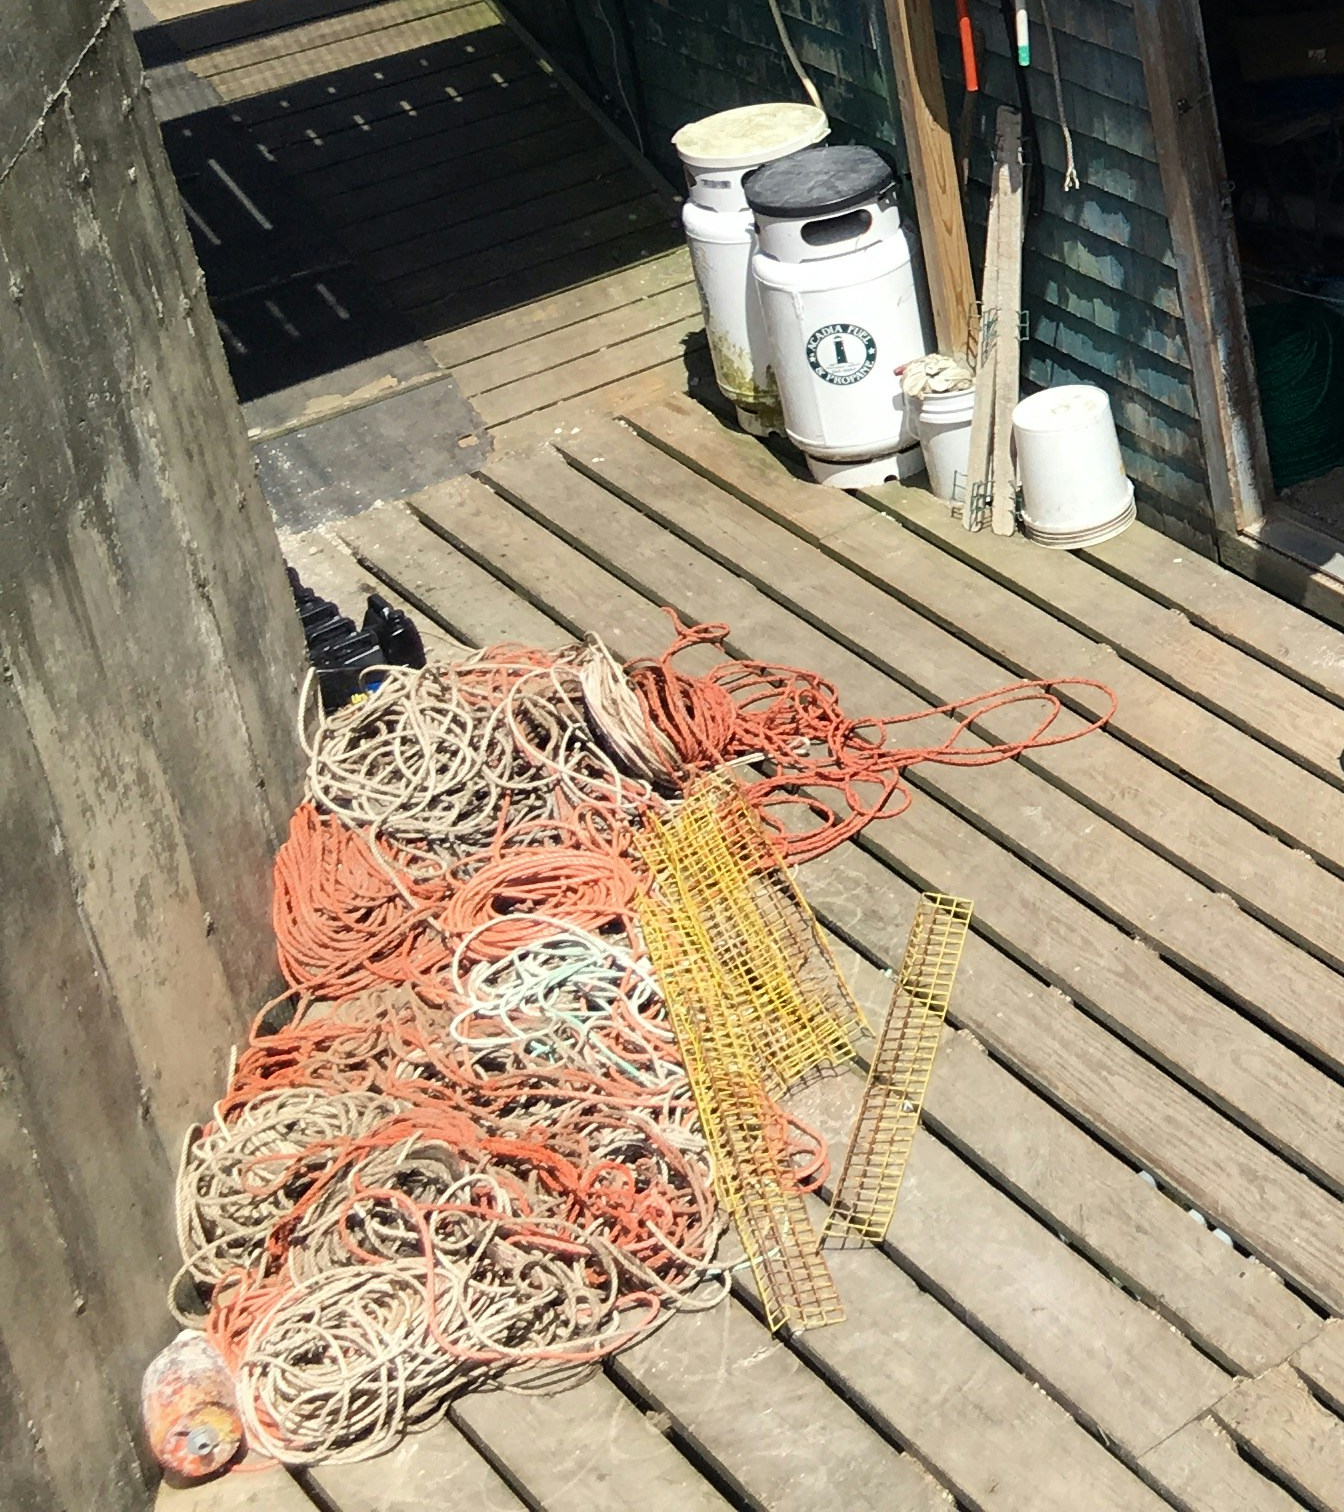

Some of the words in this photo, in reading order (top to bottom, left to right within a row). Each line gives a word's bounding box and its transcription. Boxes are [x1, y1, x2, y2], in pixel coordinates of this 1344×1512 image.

[808, 325, 843, 352] ACADIA
[847, 326, 871, 345] FUEL
[825, 360, 874, 384] PROPANE
